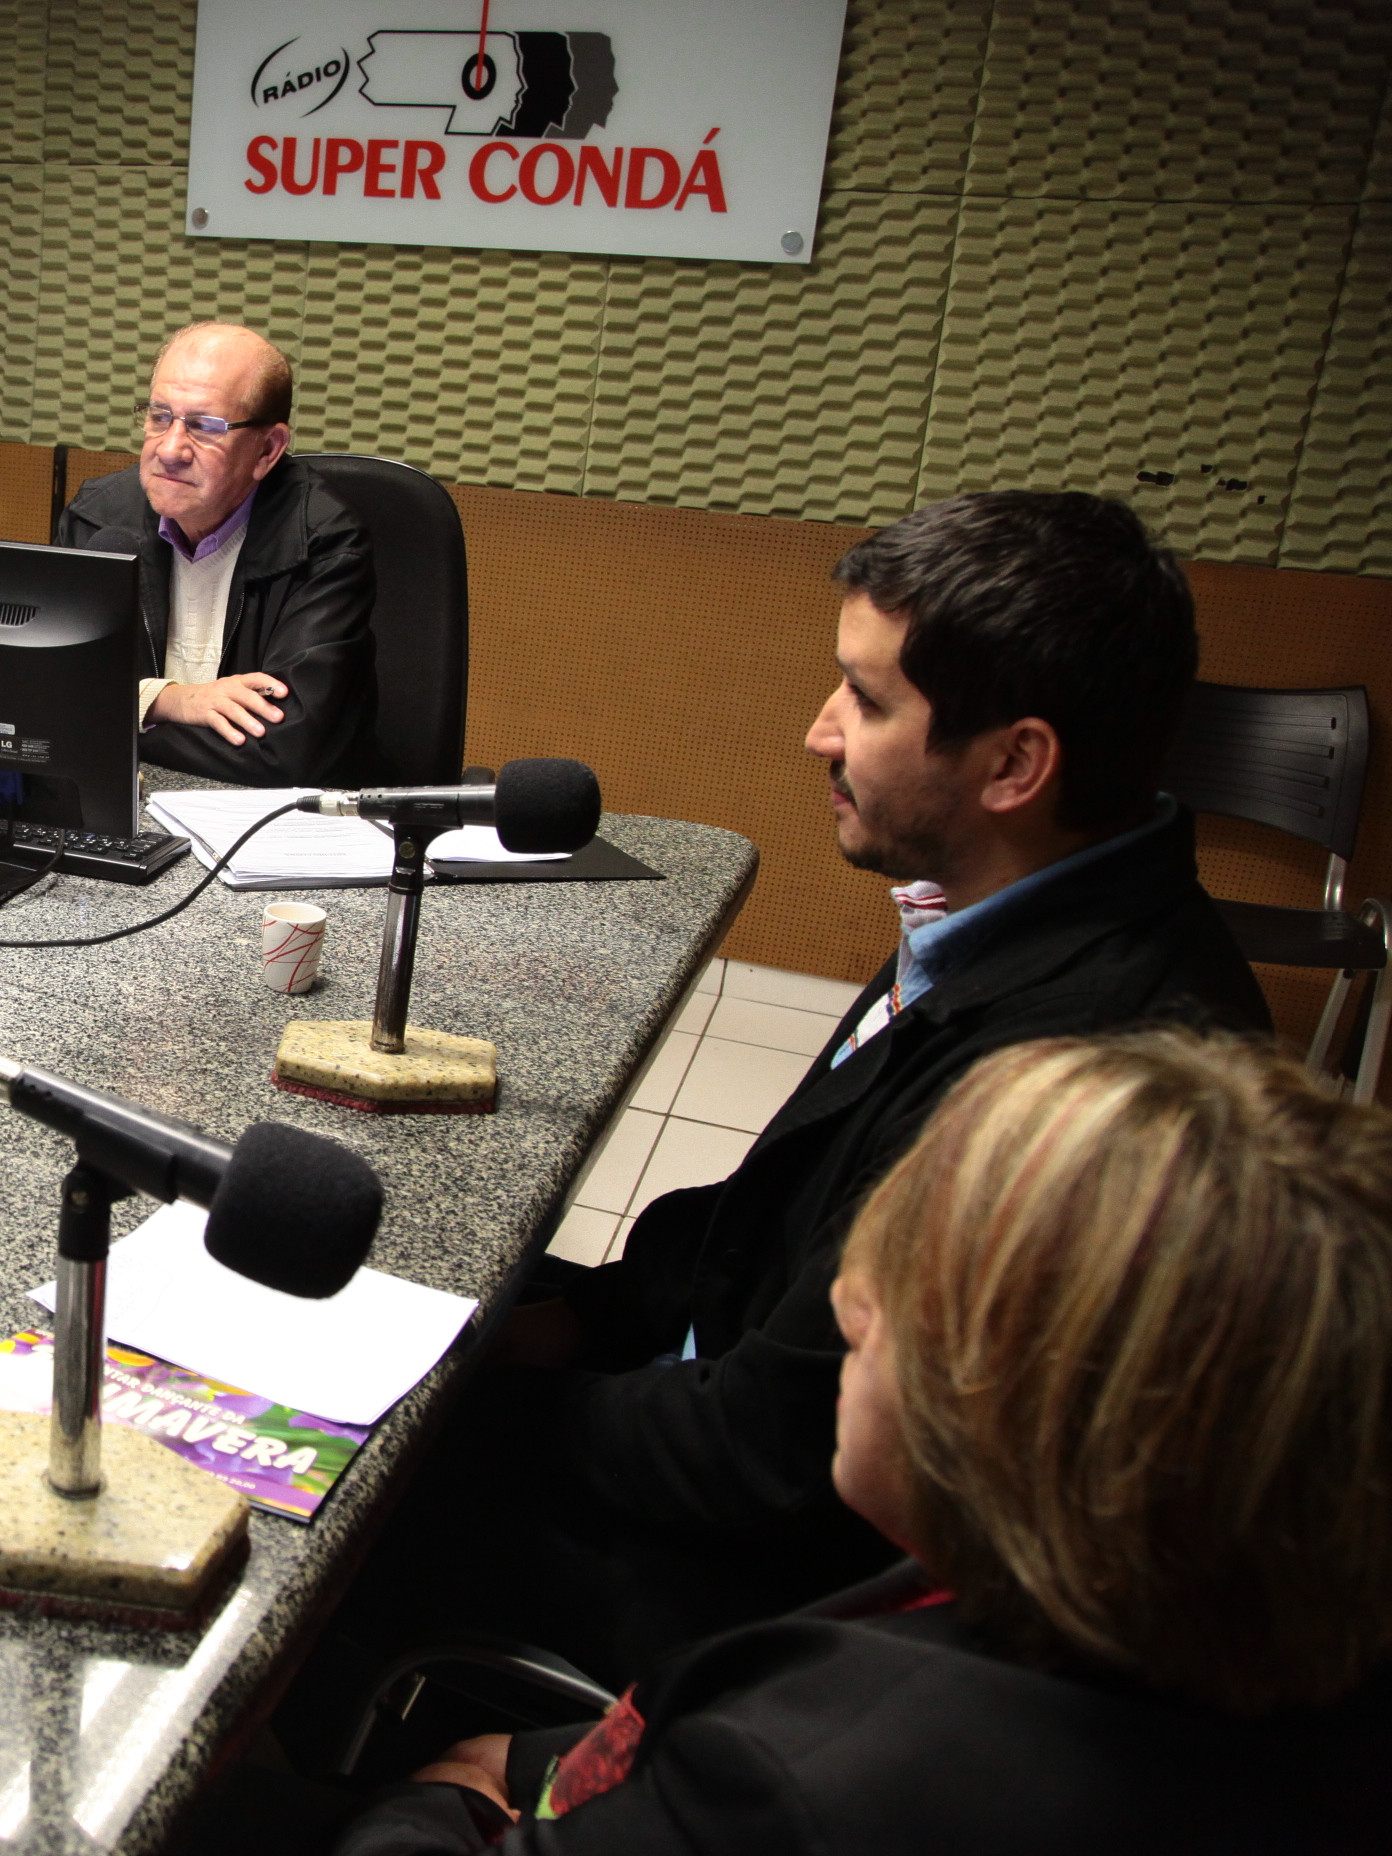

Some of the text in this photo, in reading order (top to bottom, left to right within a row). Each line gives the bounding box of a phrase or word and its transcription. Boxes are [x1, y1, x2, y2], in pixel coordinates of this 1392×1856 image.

[262, 57, 341, 105] RÁDIO
[244, 127, 728, 213] SUPER CONDÁ
[1, 740, 13, 748] LG
[103, 1365, 246, 1425] NTAR DANÇANTE DA
